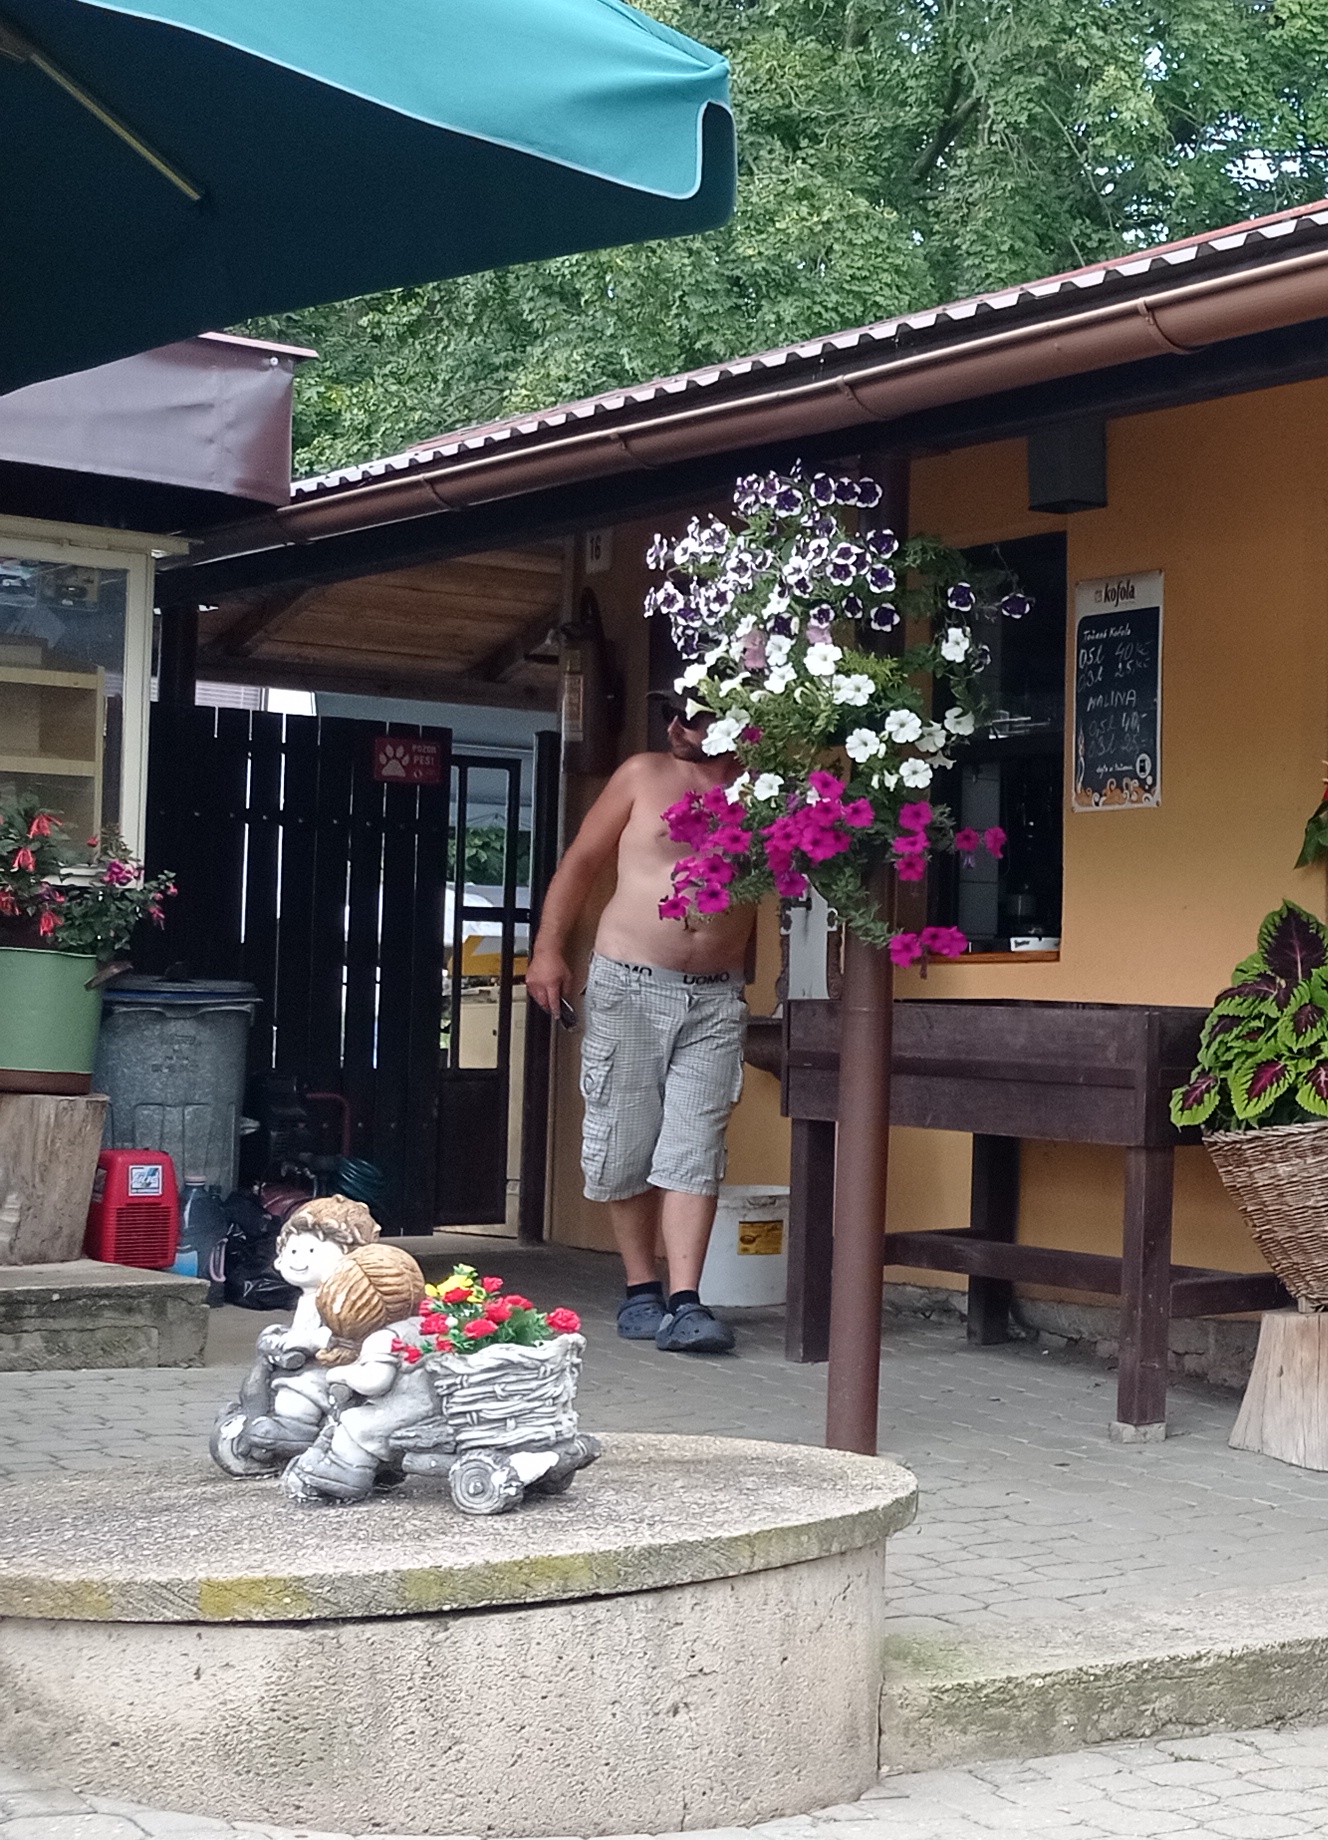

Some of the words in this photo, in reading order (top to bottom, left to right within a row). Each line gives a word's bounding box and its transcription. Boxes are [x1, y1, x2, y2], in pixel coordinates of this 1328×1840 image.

[1104, 580, 1135, 608] kofola
[1087, 689, 1136, 712] MALINA
[682, 971, 730, 985] UOMO
